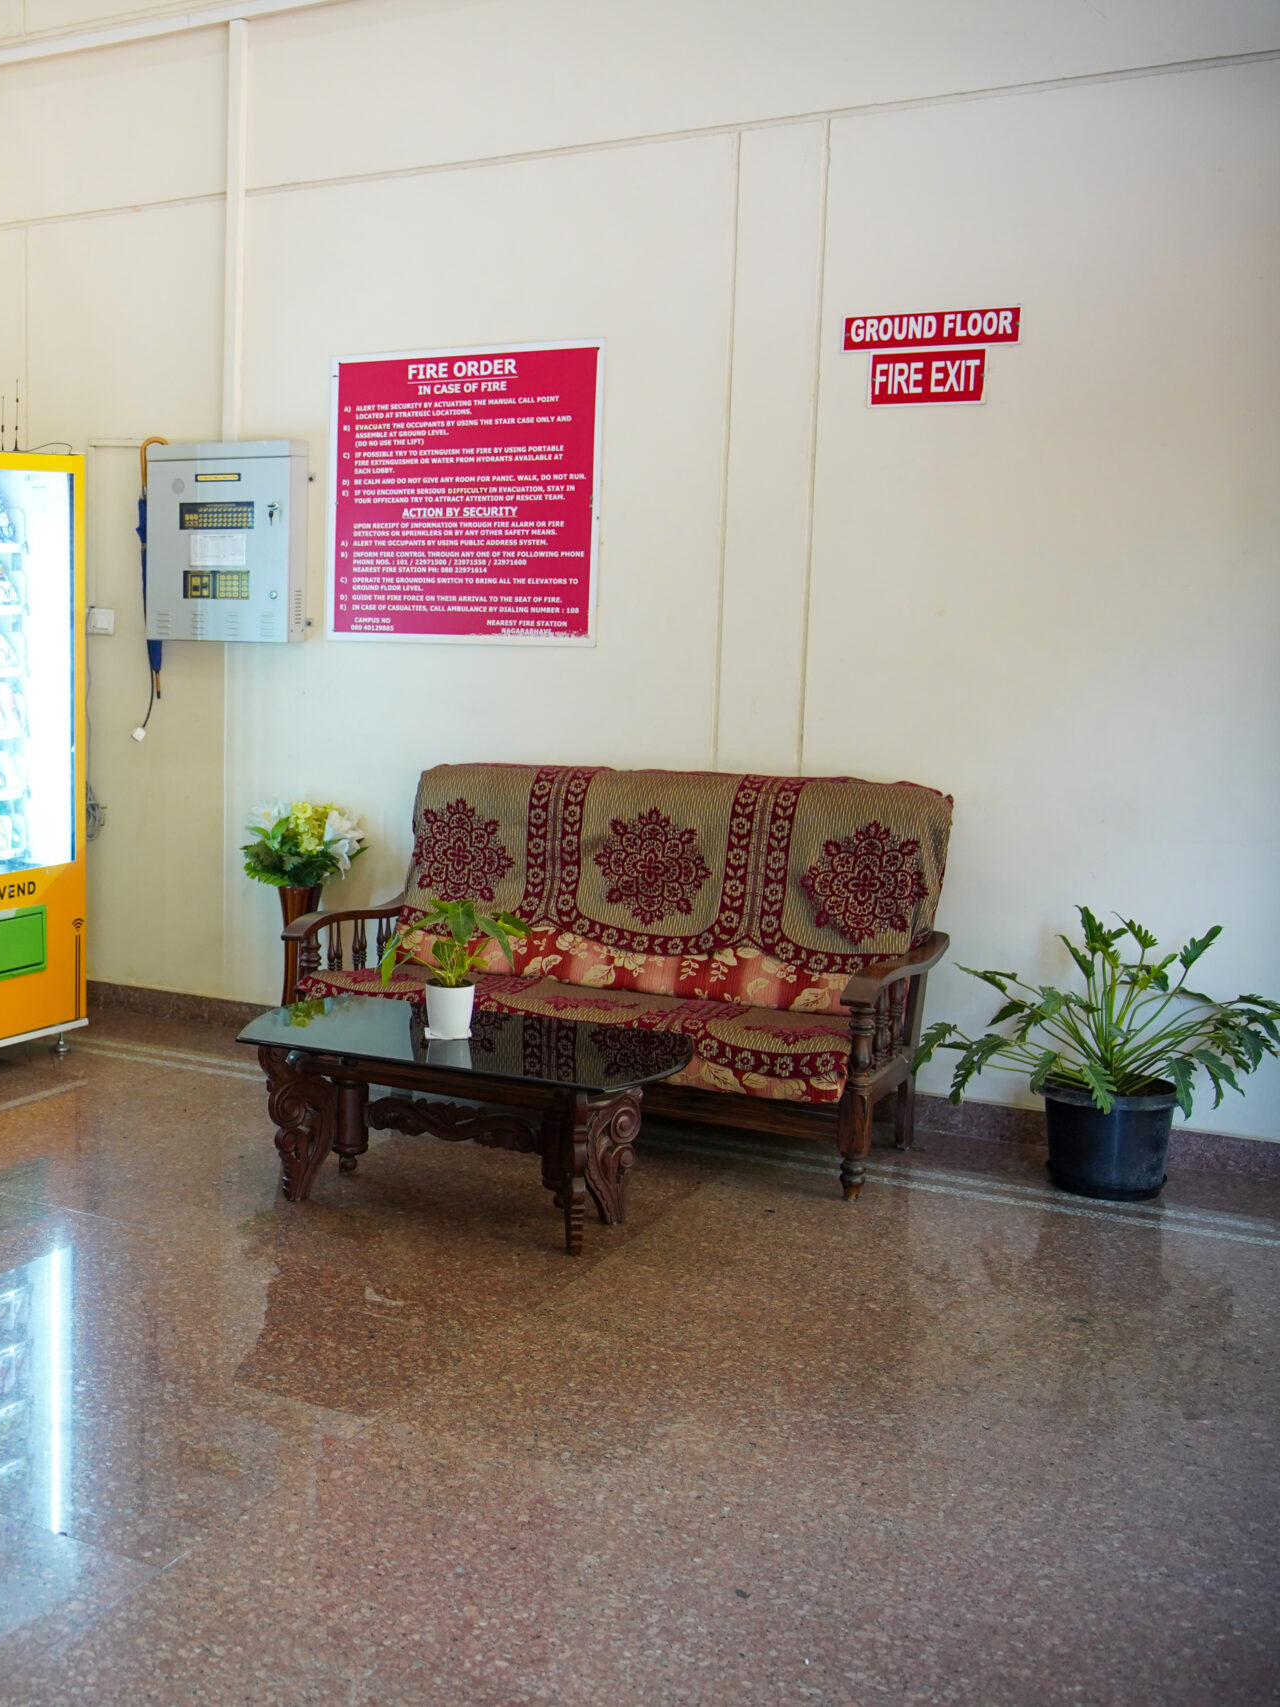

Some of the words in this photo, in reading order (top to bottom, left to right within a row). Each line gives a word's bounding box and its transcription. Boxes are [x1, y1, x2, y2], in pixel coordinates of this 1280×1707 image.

[850, 315, 937, 342] GROUND
[943, 310, 1013, 337] FLOOR
[408, 362, 448, 379] FIRE
[453, 358, 516, 377] ORDER
[874, 361, 924, 395] FIRE
[930, 359, 980, 393] EXIT
[418, 384, 430, 395] IN
[433, 383, 460, 394] CASE
[463, 382, 478, 393] OF
[481, 380, 506, 392] FIRE
[433, 400, 471, 408] ACTUATING
[402, 507, 442, 517] ACTION
[446, 507, 460, 516] BY
[462, 506, 517, 516] SECURITY
